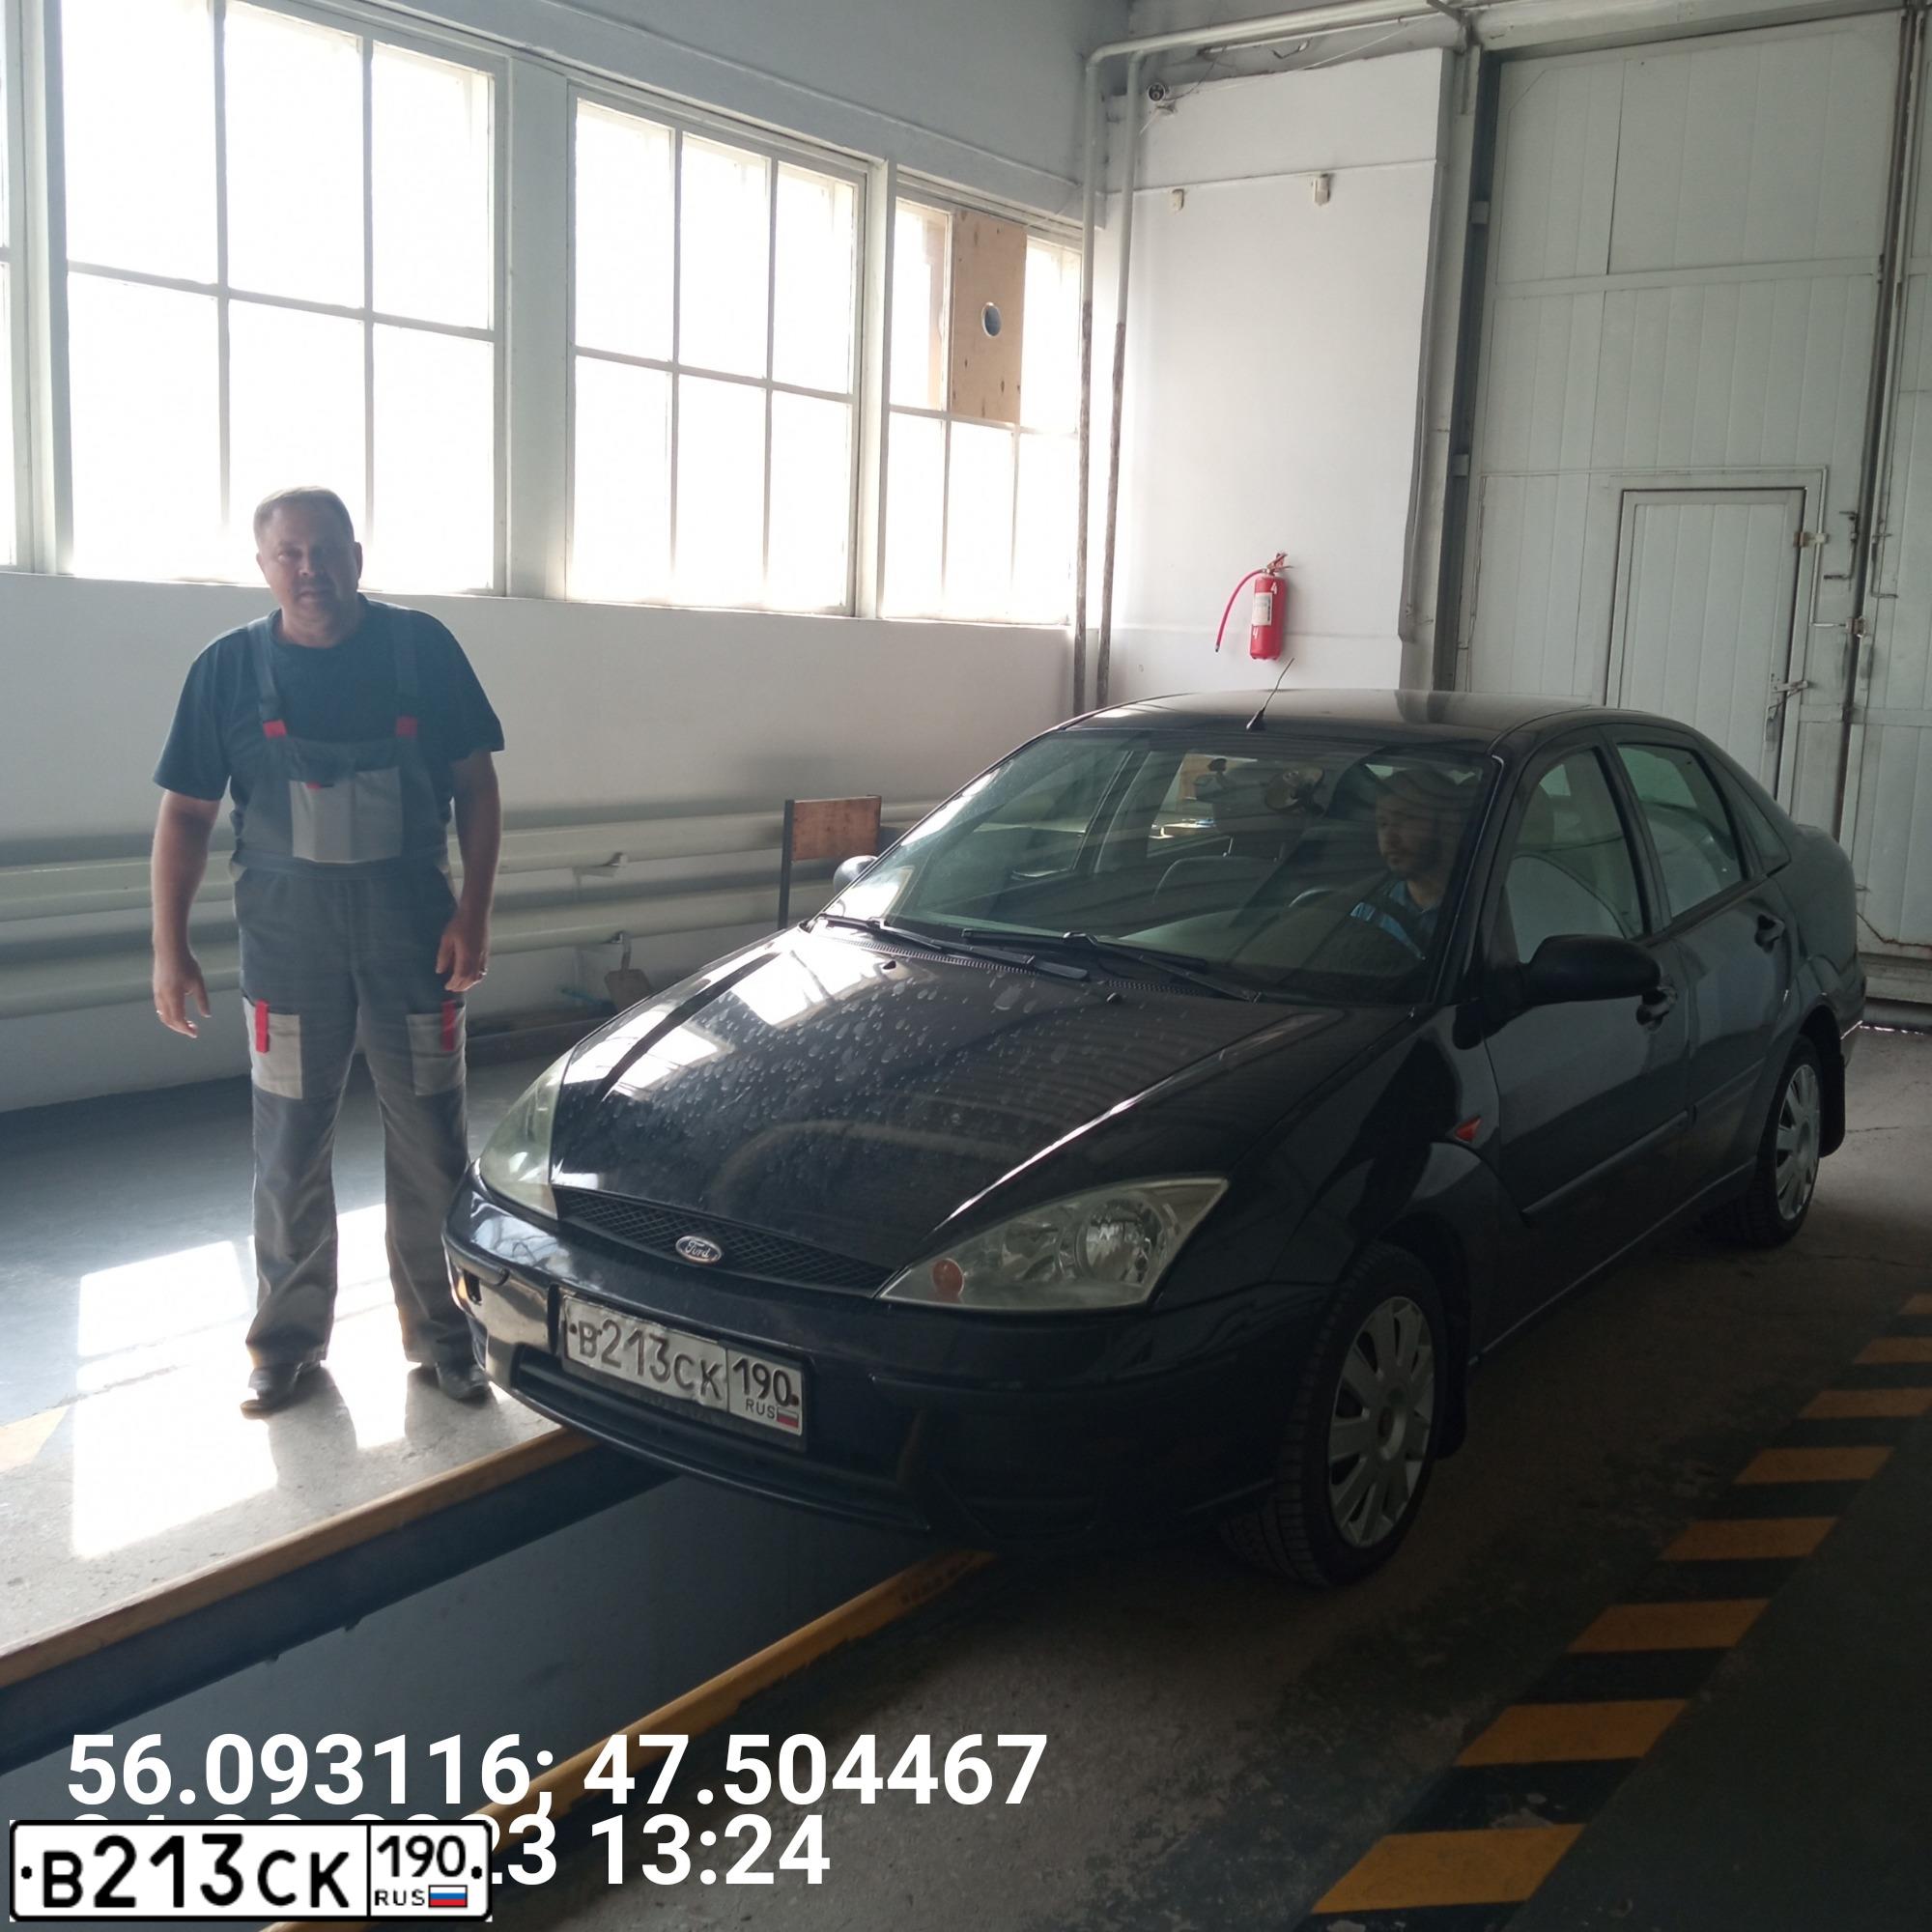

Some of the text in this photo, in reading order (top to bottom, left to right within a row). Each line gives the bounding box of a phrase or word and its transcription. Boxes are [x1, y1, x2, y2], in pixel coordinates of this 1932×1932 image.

[685, 1240, 711, 1259] Ford
[732, 1356, 793, 1407] 190
[745, 1398, 776, 1420] RUS
